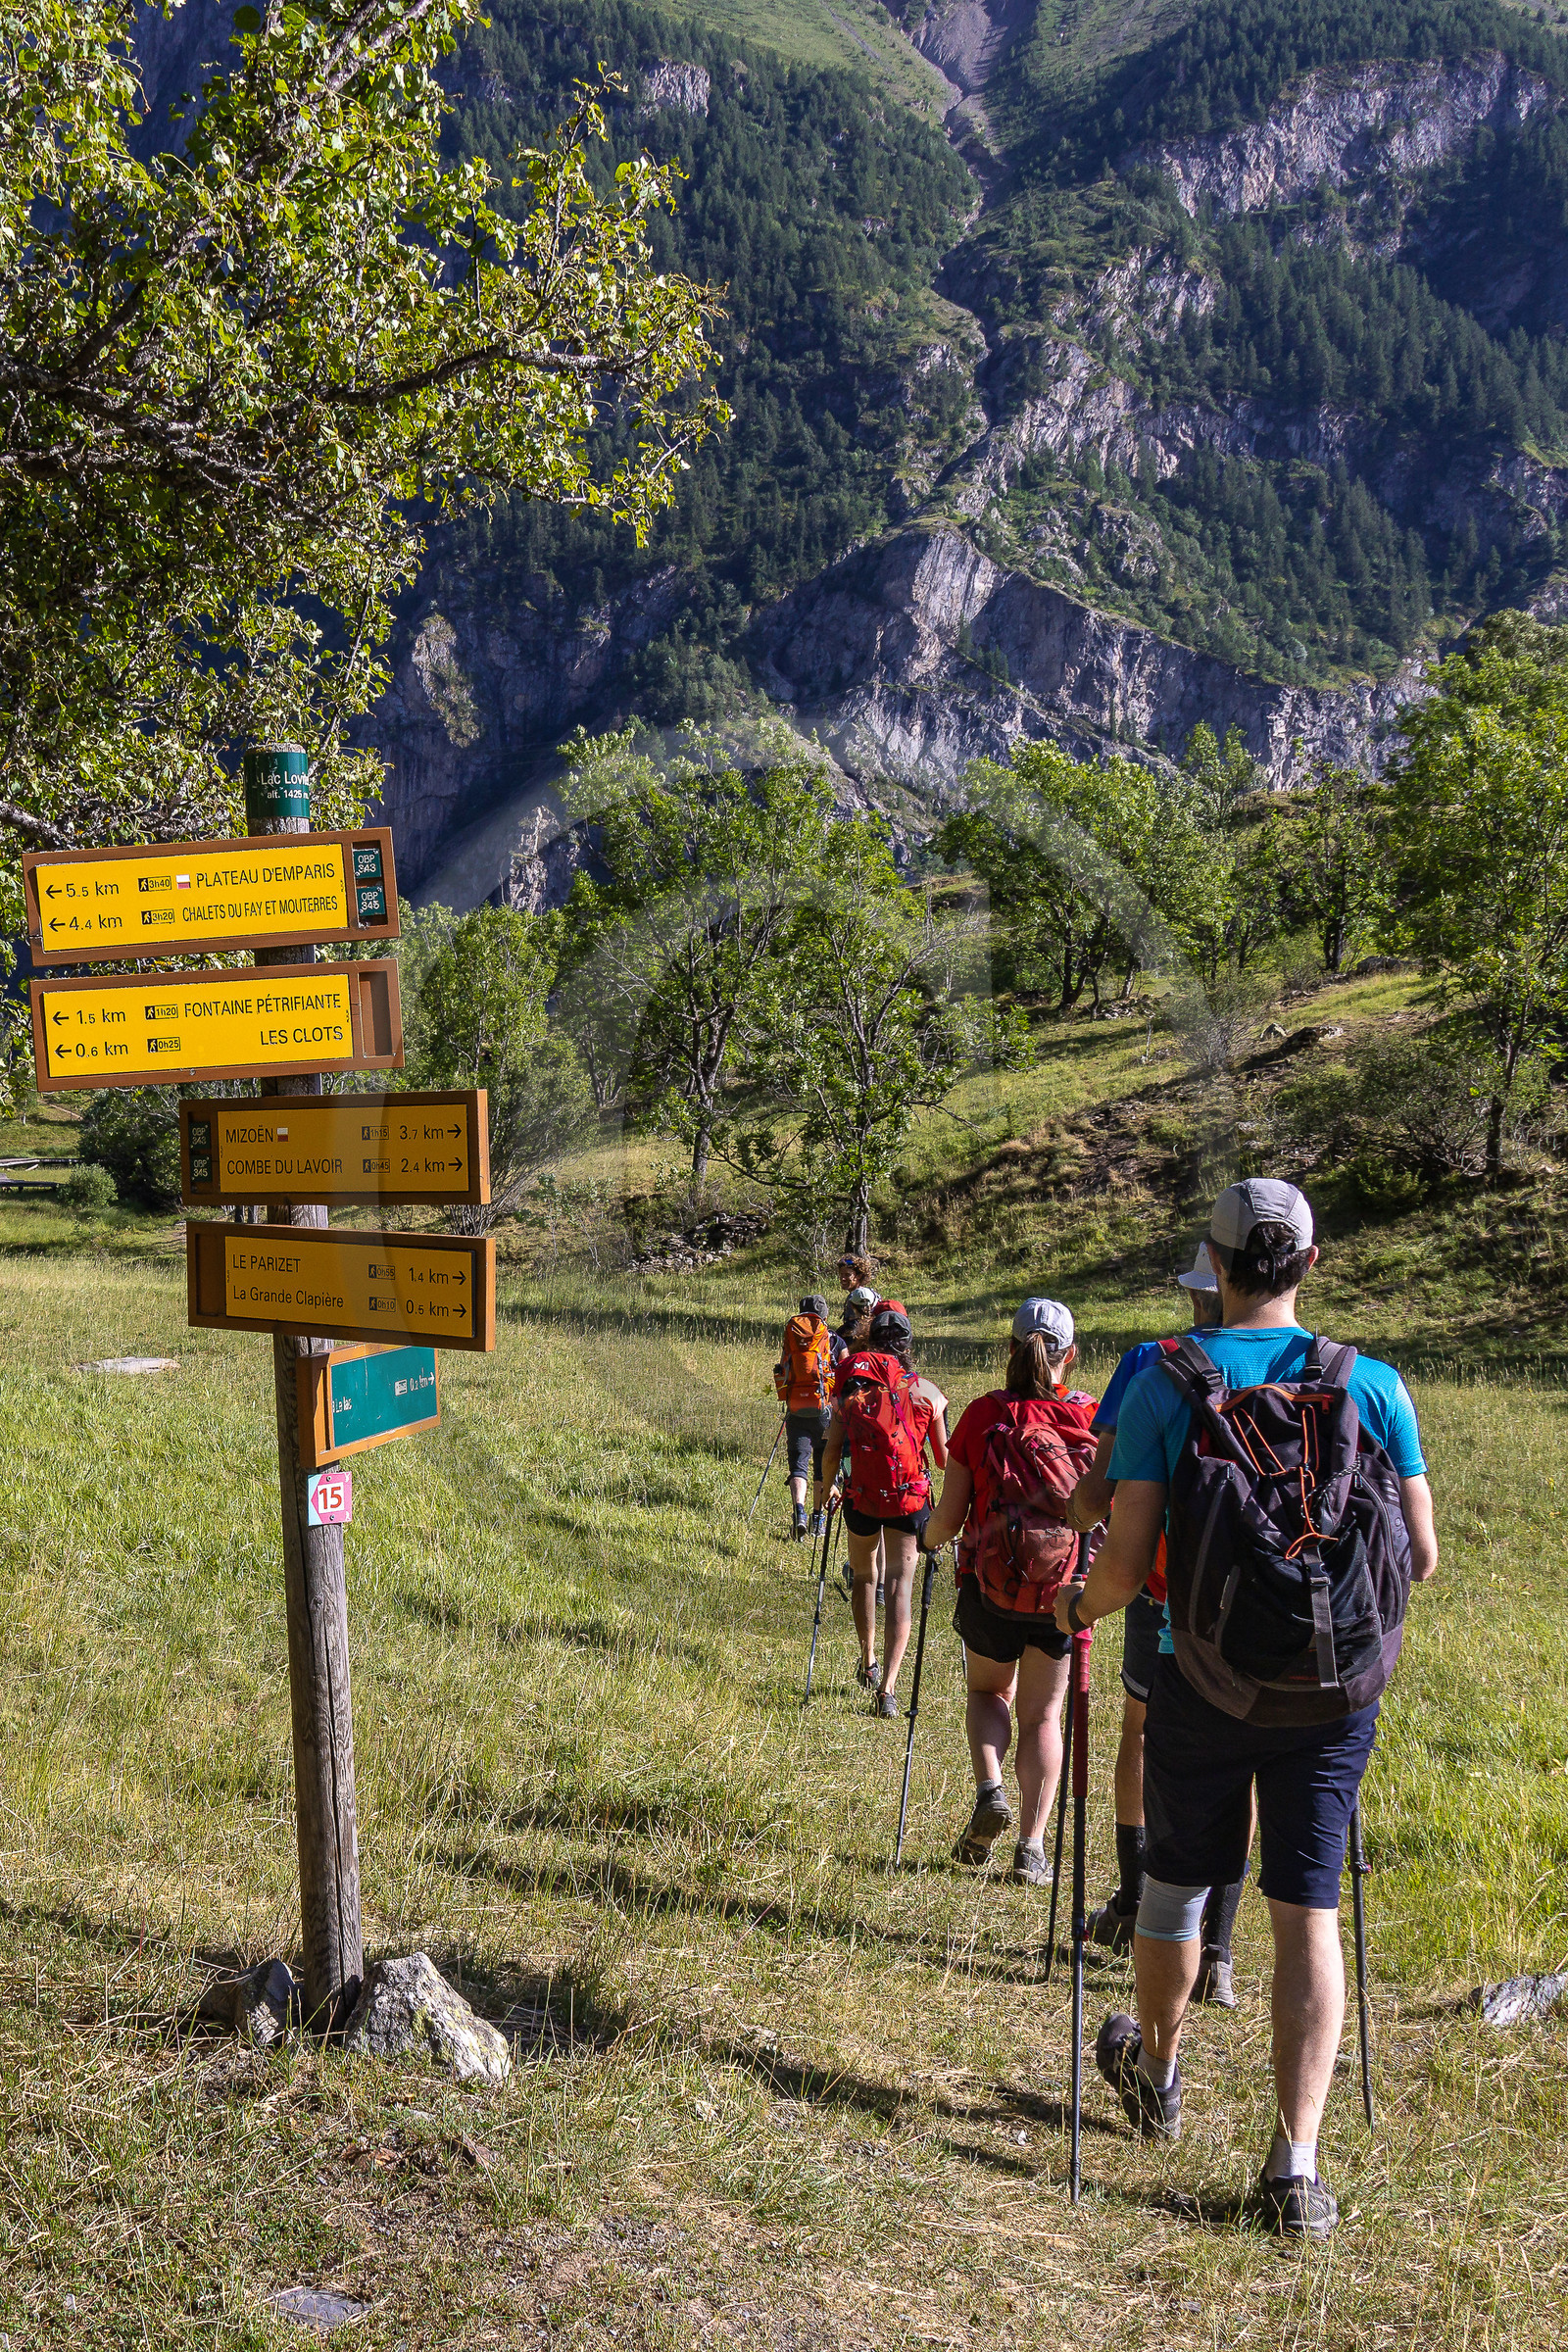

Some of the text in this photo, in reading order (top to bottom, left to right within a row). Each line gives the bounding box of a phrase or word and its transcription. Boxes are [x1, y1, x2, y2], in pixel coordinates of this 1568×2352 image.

[261, 772, 281, 785] Lac
[267, 790, 280, 799] alt.
[283, 789, 303, 799] 1425
[358, 855, 375, 864] OBP
[358, 863, 376, 873] 343
[66, 863, 335, 898] 5.5 km 3h40 PLATEAU D'EMPARIS
[361, 891, 378, 902] OBP
[69, 896, 338, 931] 4.4 km 3h20 CHALETS DU FAY ET MOUTERRES
[76, 993, 341, 1025] 1.5 km 1h20 FONTAINE PÉTRIFIANTE
[75, 1025, 343, 1057] 0.6 km 0h25 LES CLOTS
[225, 1124, 444, 1143] MIZOËN 1h15 3.7 km
[193, 1168, 209, 1177] 345
[226, 1157, 445, 1175] COMBE DU LAVOIR 0h45 2.4 km
[232, 1253, 449, 1285] LE PARIZET 0h55 1.4 km
[233, 1285, 449, 1317] La Grande Clapière 0h10 0.5 km
[318, 1486, 342, 1510] 15
